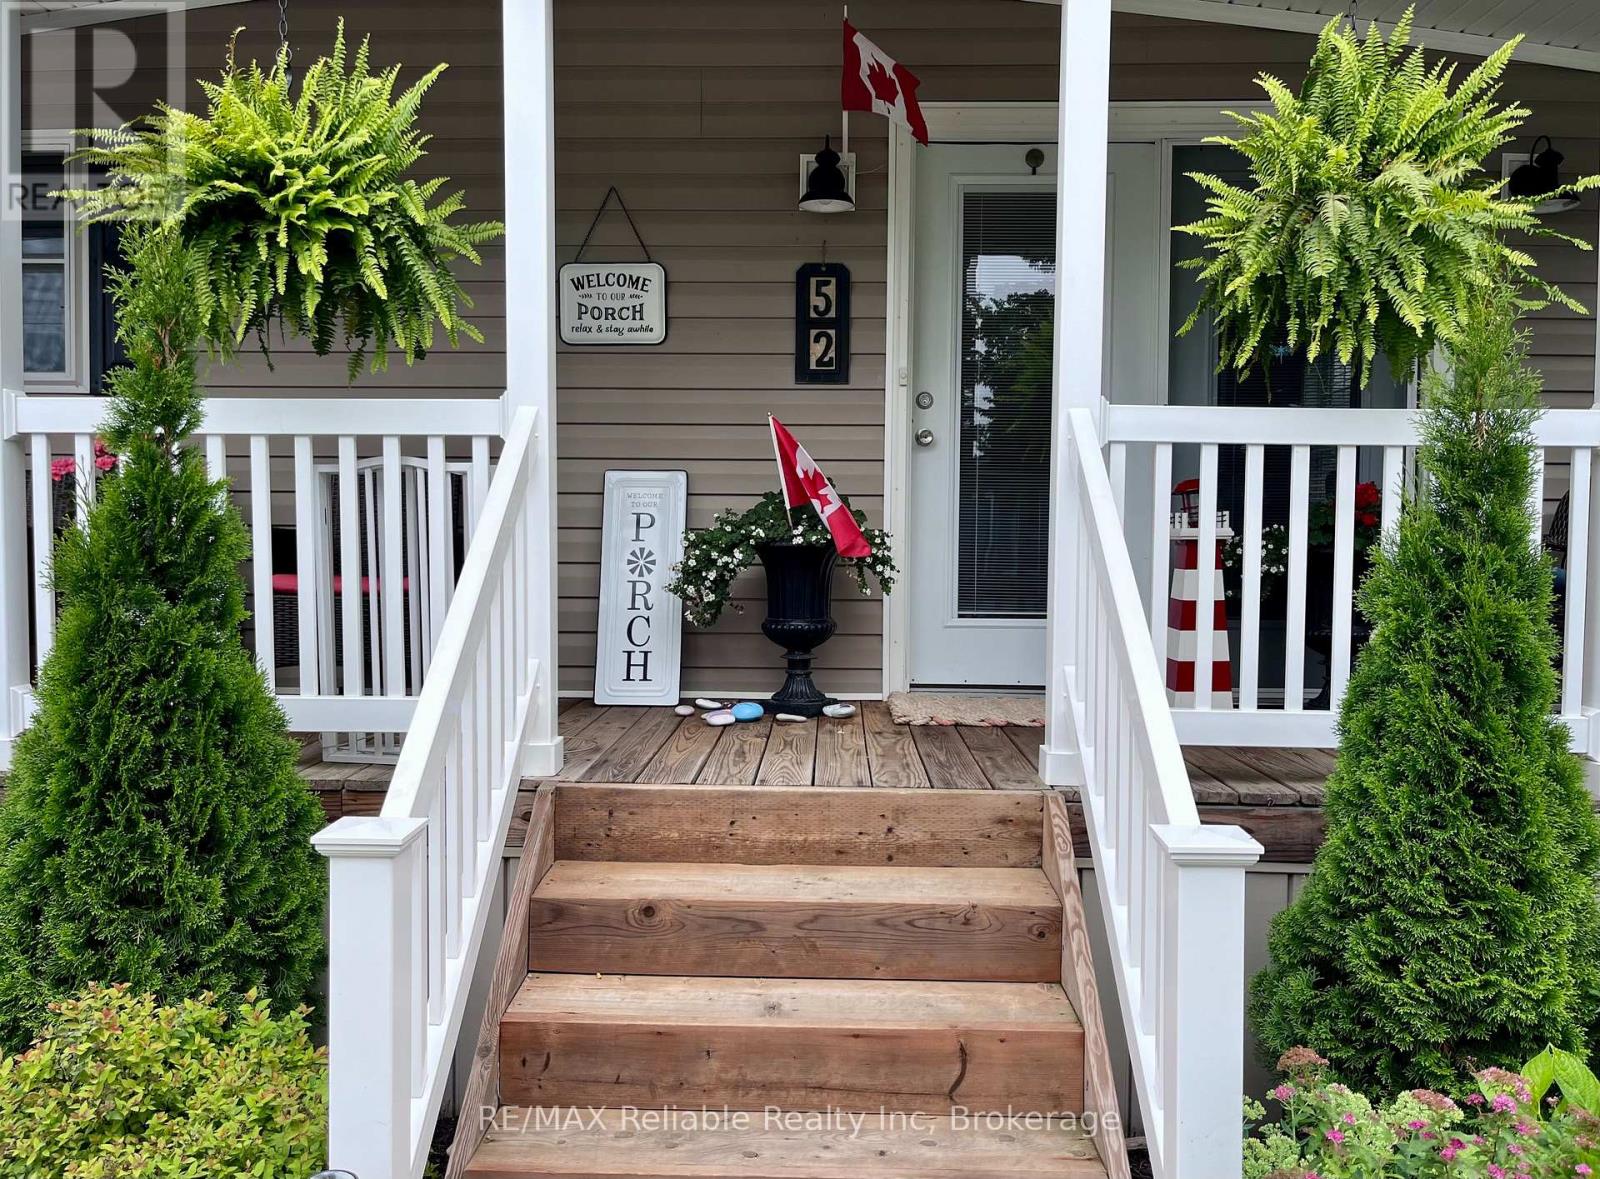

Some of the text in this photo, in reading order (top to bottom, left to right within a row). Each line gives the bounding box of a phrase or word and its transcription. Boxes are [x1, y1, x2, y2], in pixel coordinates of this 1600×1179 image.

[570, 272, 652, 293] WELCOME
[596, 292, 626, 301] TO OUR
[577, 302, 645, 321] PORCH
[571, 323, 654, 337] relax & stay awhile
